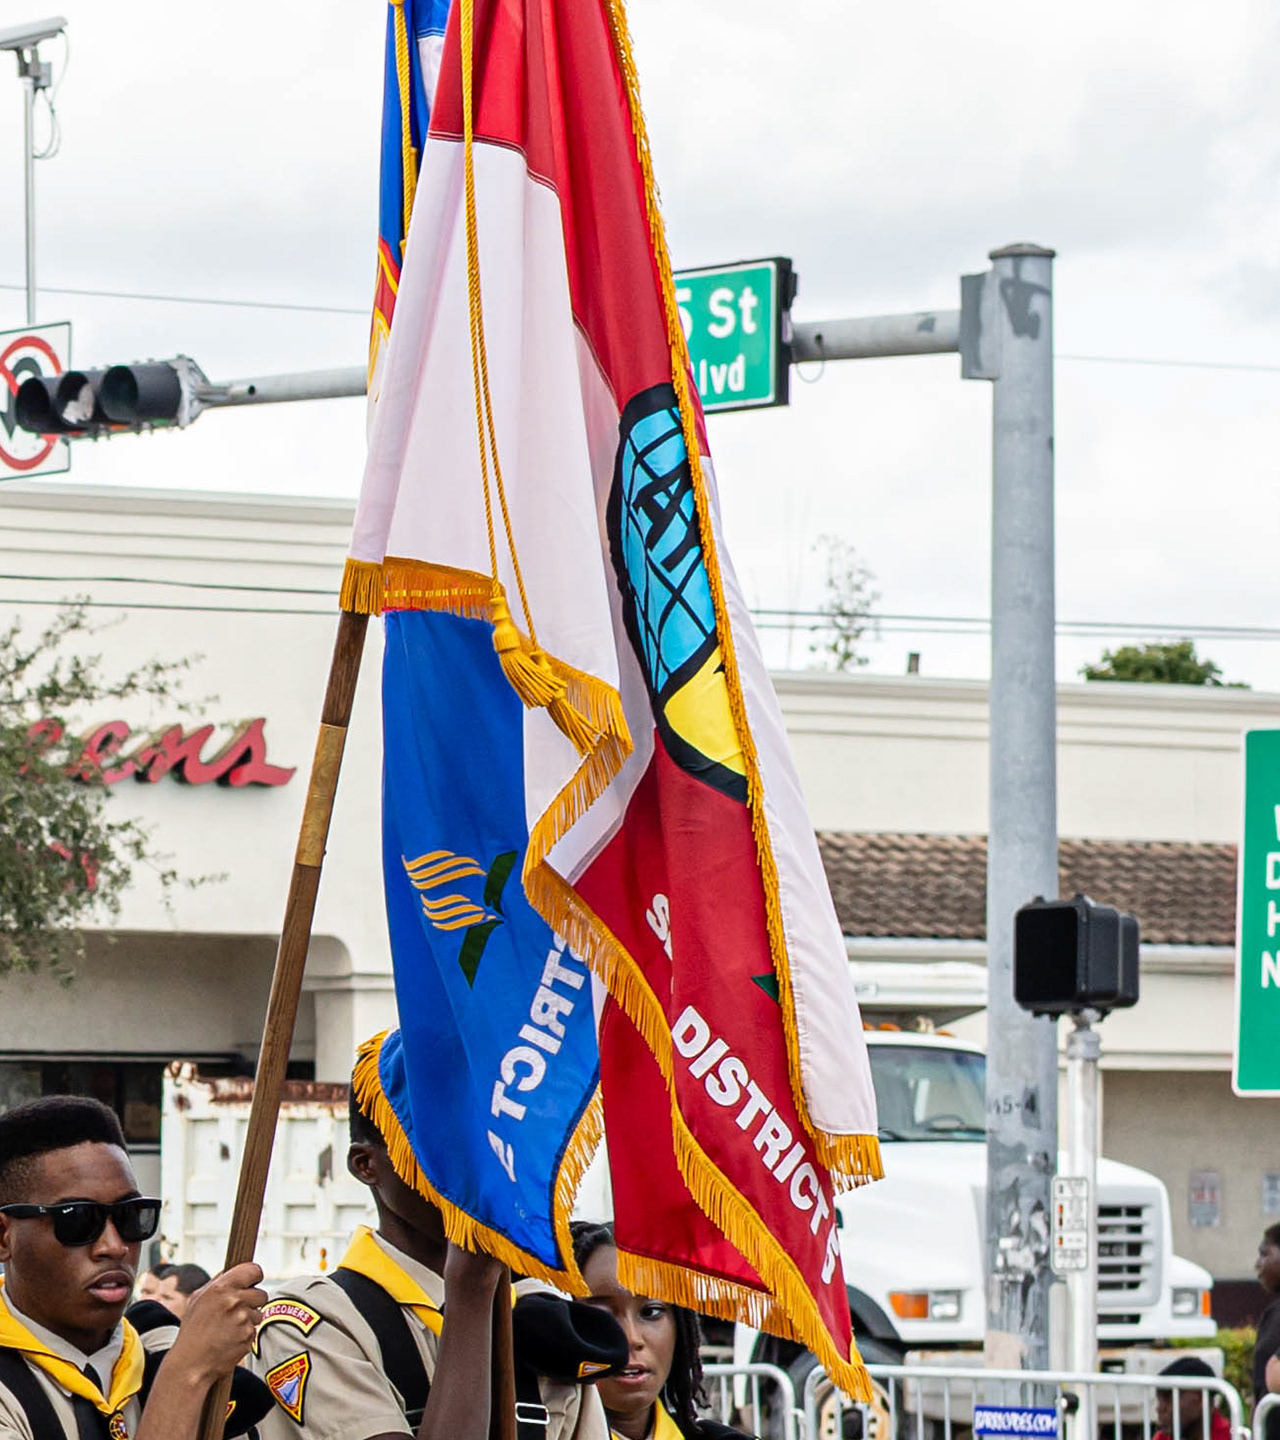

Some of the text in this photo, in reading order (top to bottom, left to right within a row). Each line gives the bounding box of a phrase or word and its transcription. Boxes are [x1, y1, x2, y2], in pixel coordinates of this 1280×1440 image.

[708, 286, 757, 338] St
[690, 354, 745, 395] lvd
[671, 1005, 831, 1236] DISTRICT
